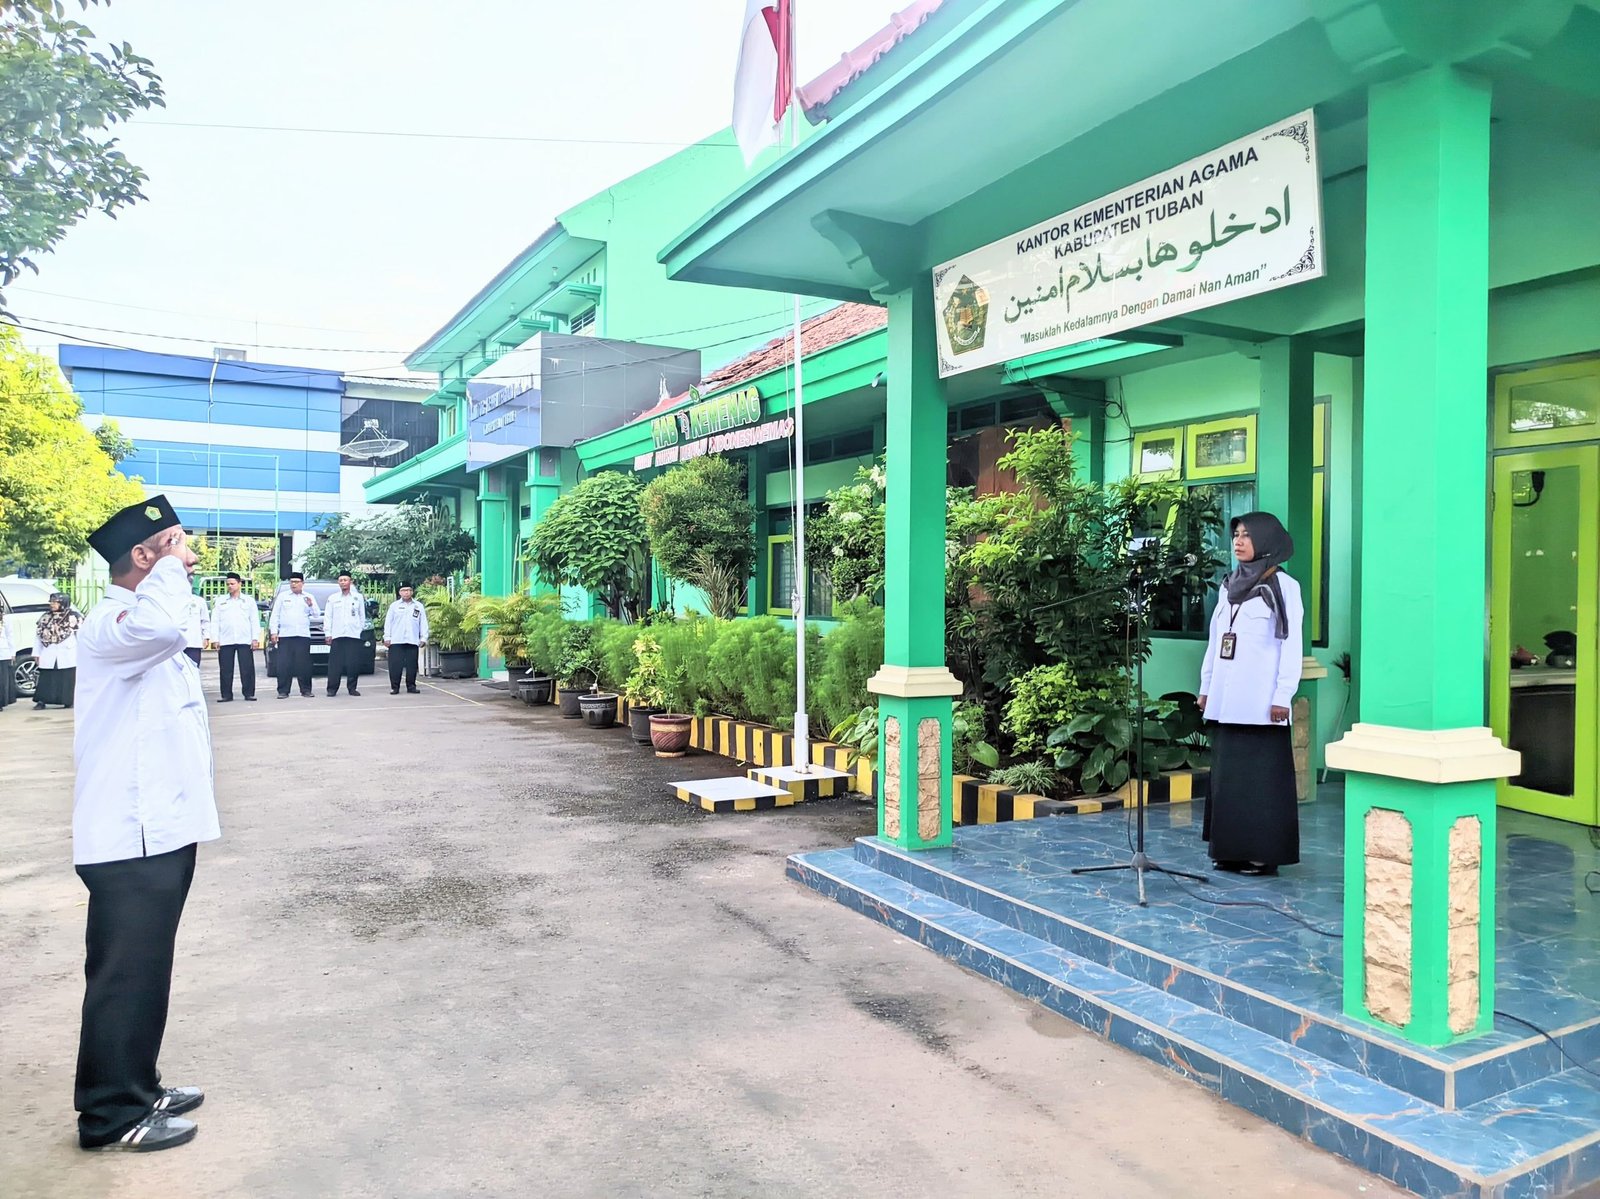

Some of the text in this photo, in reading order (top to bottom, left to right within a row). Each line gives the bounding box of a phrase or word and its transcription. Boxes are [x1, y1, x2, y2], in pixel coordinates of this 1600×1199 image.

[1016, 146, 1259, 255] KANTOR KEMENTERIAN AGAMA
[1054, 190, 1203, 259] KABUPATEN TUBAN
[1063, 309, 1118, 333] Kedalamnya
[1121, 297, 1159, 317] Dengan
[1162, 284, 1196, 305] Damai
[1199, 281, 1221, 295] Nan
[651, 414, 679, 449] HAB
[689, 384, 761, 439] KEMENAG
